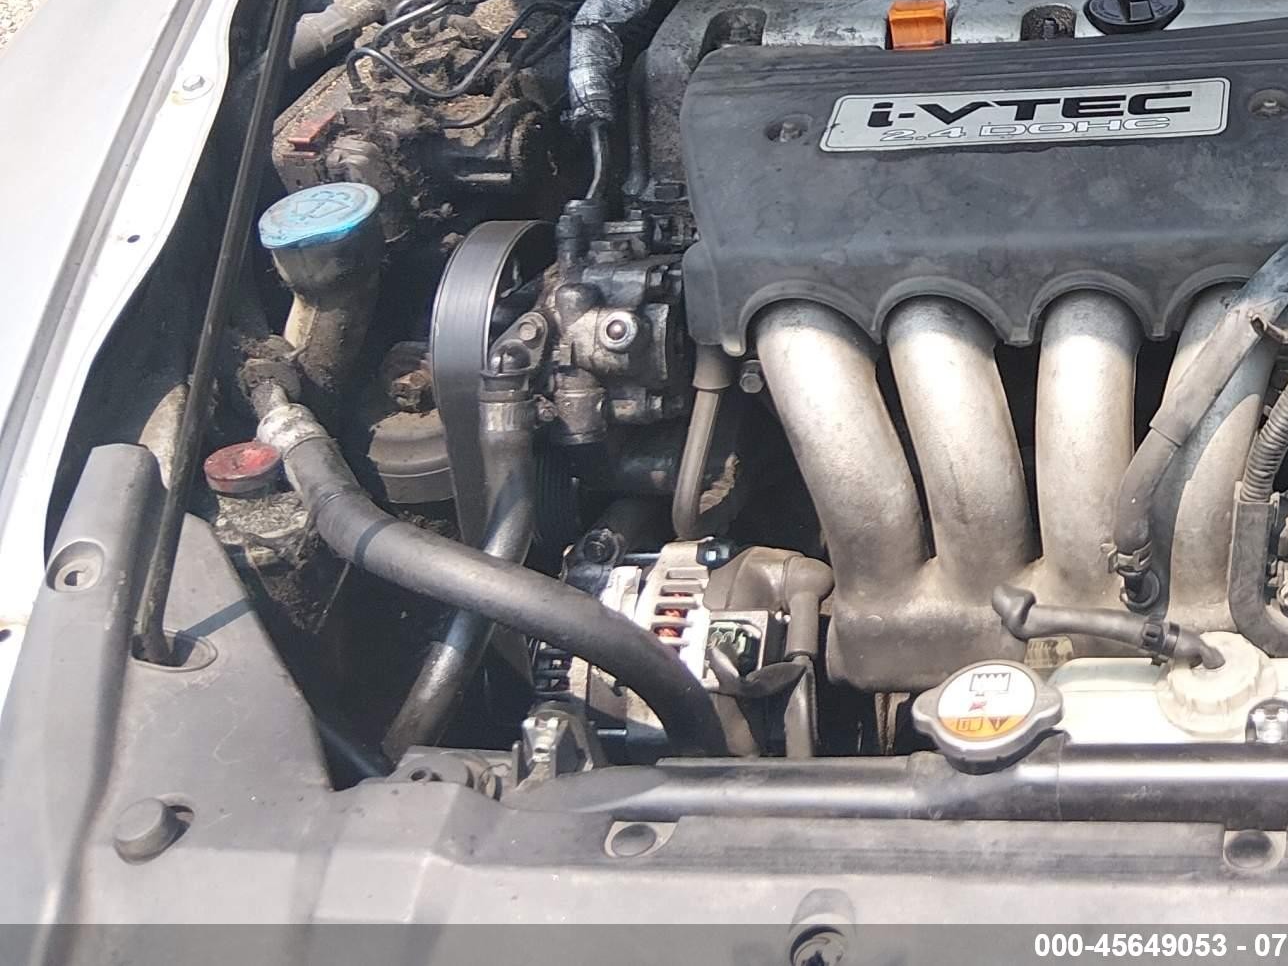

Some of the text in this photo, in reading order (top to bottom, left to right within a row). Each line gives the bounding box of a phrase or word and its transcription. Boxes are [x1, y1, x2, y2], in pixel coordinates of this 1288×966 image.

[866, 90, 1193, 128] i-VTEC
[880, 116, 1171, 143] 2.4 DOHC
